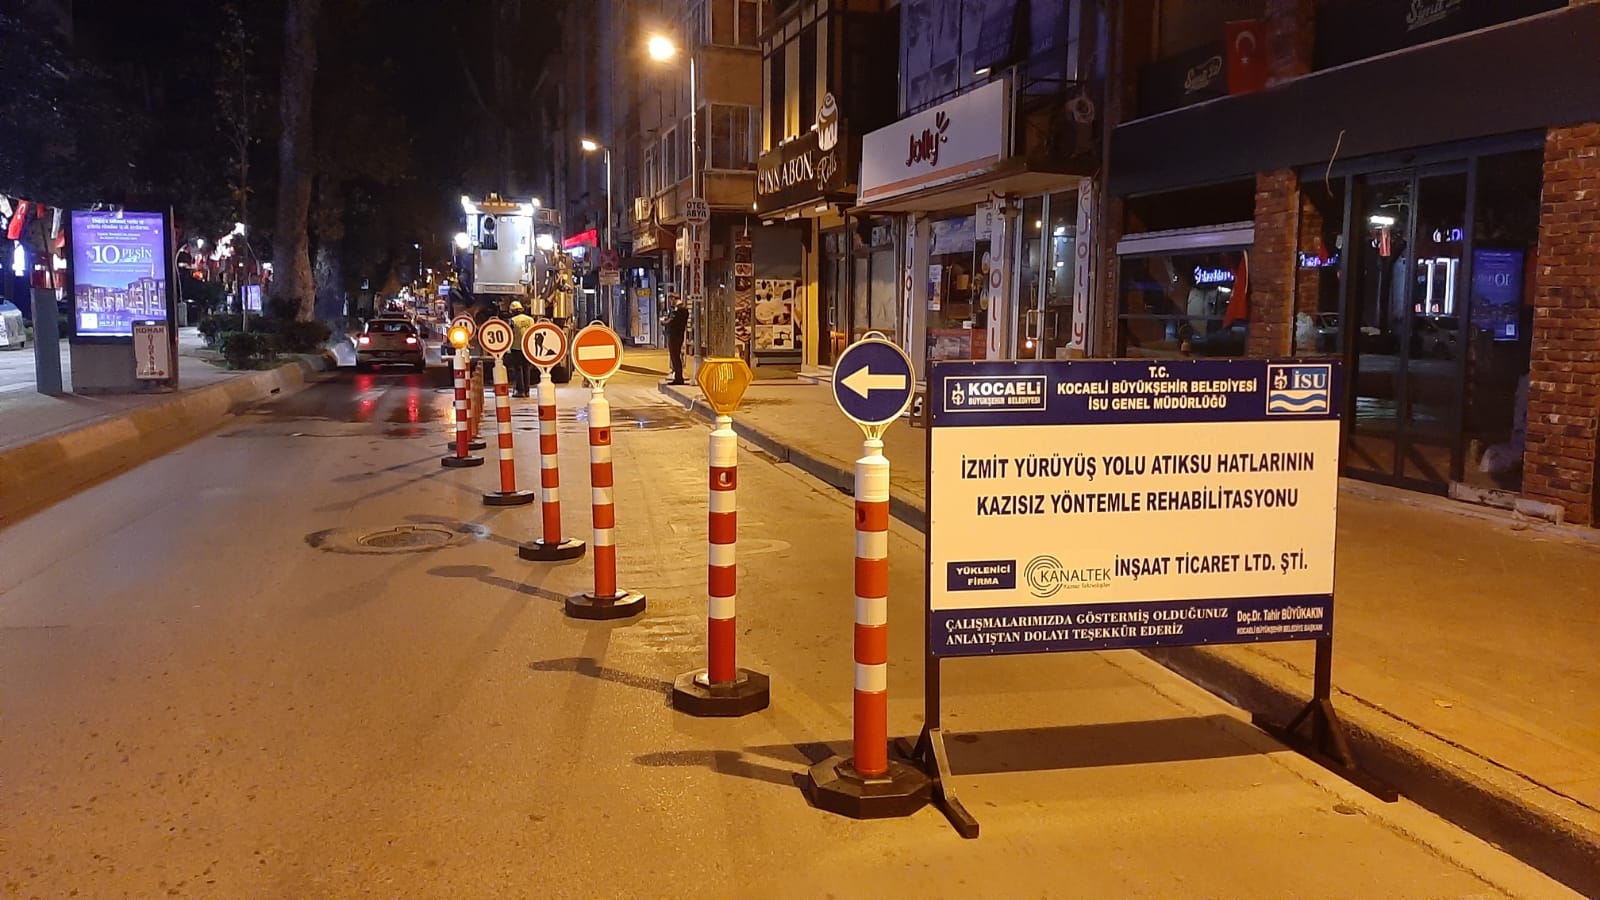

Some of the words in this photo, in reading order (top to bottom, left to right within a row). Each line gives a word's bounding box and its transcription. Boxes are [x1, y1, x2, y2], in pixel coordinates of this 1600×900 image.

[905, 128, 940, 167] Jolly
[686, 201, 706, 209] OTEL
[487, 330, 504, 344] 30
[1148, 366, 1170, 378] T.C.
[1293, 370, 1327, 389] İSU
[1057, 380, 1109, 395] KOCAELİ
[1112, 379, 1189, 396] BÜYÜKŞEHİR
[1191, 378, 1257, 393] BELEDİYESİ
[1088, 396, 1108, 411] İSU
[1112, 397, 1150, 411] GENEL
[1153, 395, 1227, 409] MÜDÜRLÜĞÜ
[961, 454, 1009, 479] İZMİT
[1014, 453, 1097, 482] YÜRÜYÜŞ
[1102, 456, 1146, 476] YOLU
[1151, 454, 1212, 475] ATIKSU
[1217, 452, 1314, 473] HATLARININ
[977, 494, 1045, 516] KAZISIZ
[1050, 490, 1141, 514] YÖNTEMLE
[1146, 485, 1299, 511] REHABİLİTASYONU
[956, 563, 1011, 576] YÜKLENİCİ
[1115, 554, 1170, 581] İNŞAAT
[1175, 552, 1240, 575] TİCARET
[1244, 554, 1275, 571] LTD.
[1280, 548, 1308, 575] ŞTİ.
[967, 577, 999, 587] FİRMA
[1040, 568, 1111, 583] KANALTEK
[945, 614, 1072, 632] ÇALIŞMALARIMIZDA
[1076, 608, 1149, 625] GÖSTERMİŞ
[1153, 606, 1229, 621] OLDUĞUNUZ
[1263, 609, 1281, 621] Tahir
[1281, 606, 1324, 620] BÜYÜKAKIN
[946, 632, 1021, 645] ANLAYIŞTAN
[1024, 629, 1069, 642] DOLAYI
[1072, 626, 1137, 641] TEŞEKKÜR
[1140, 622, 1184, 636] EDERİZ
